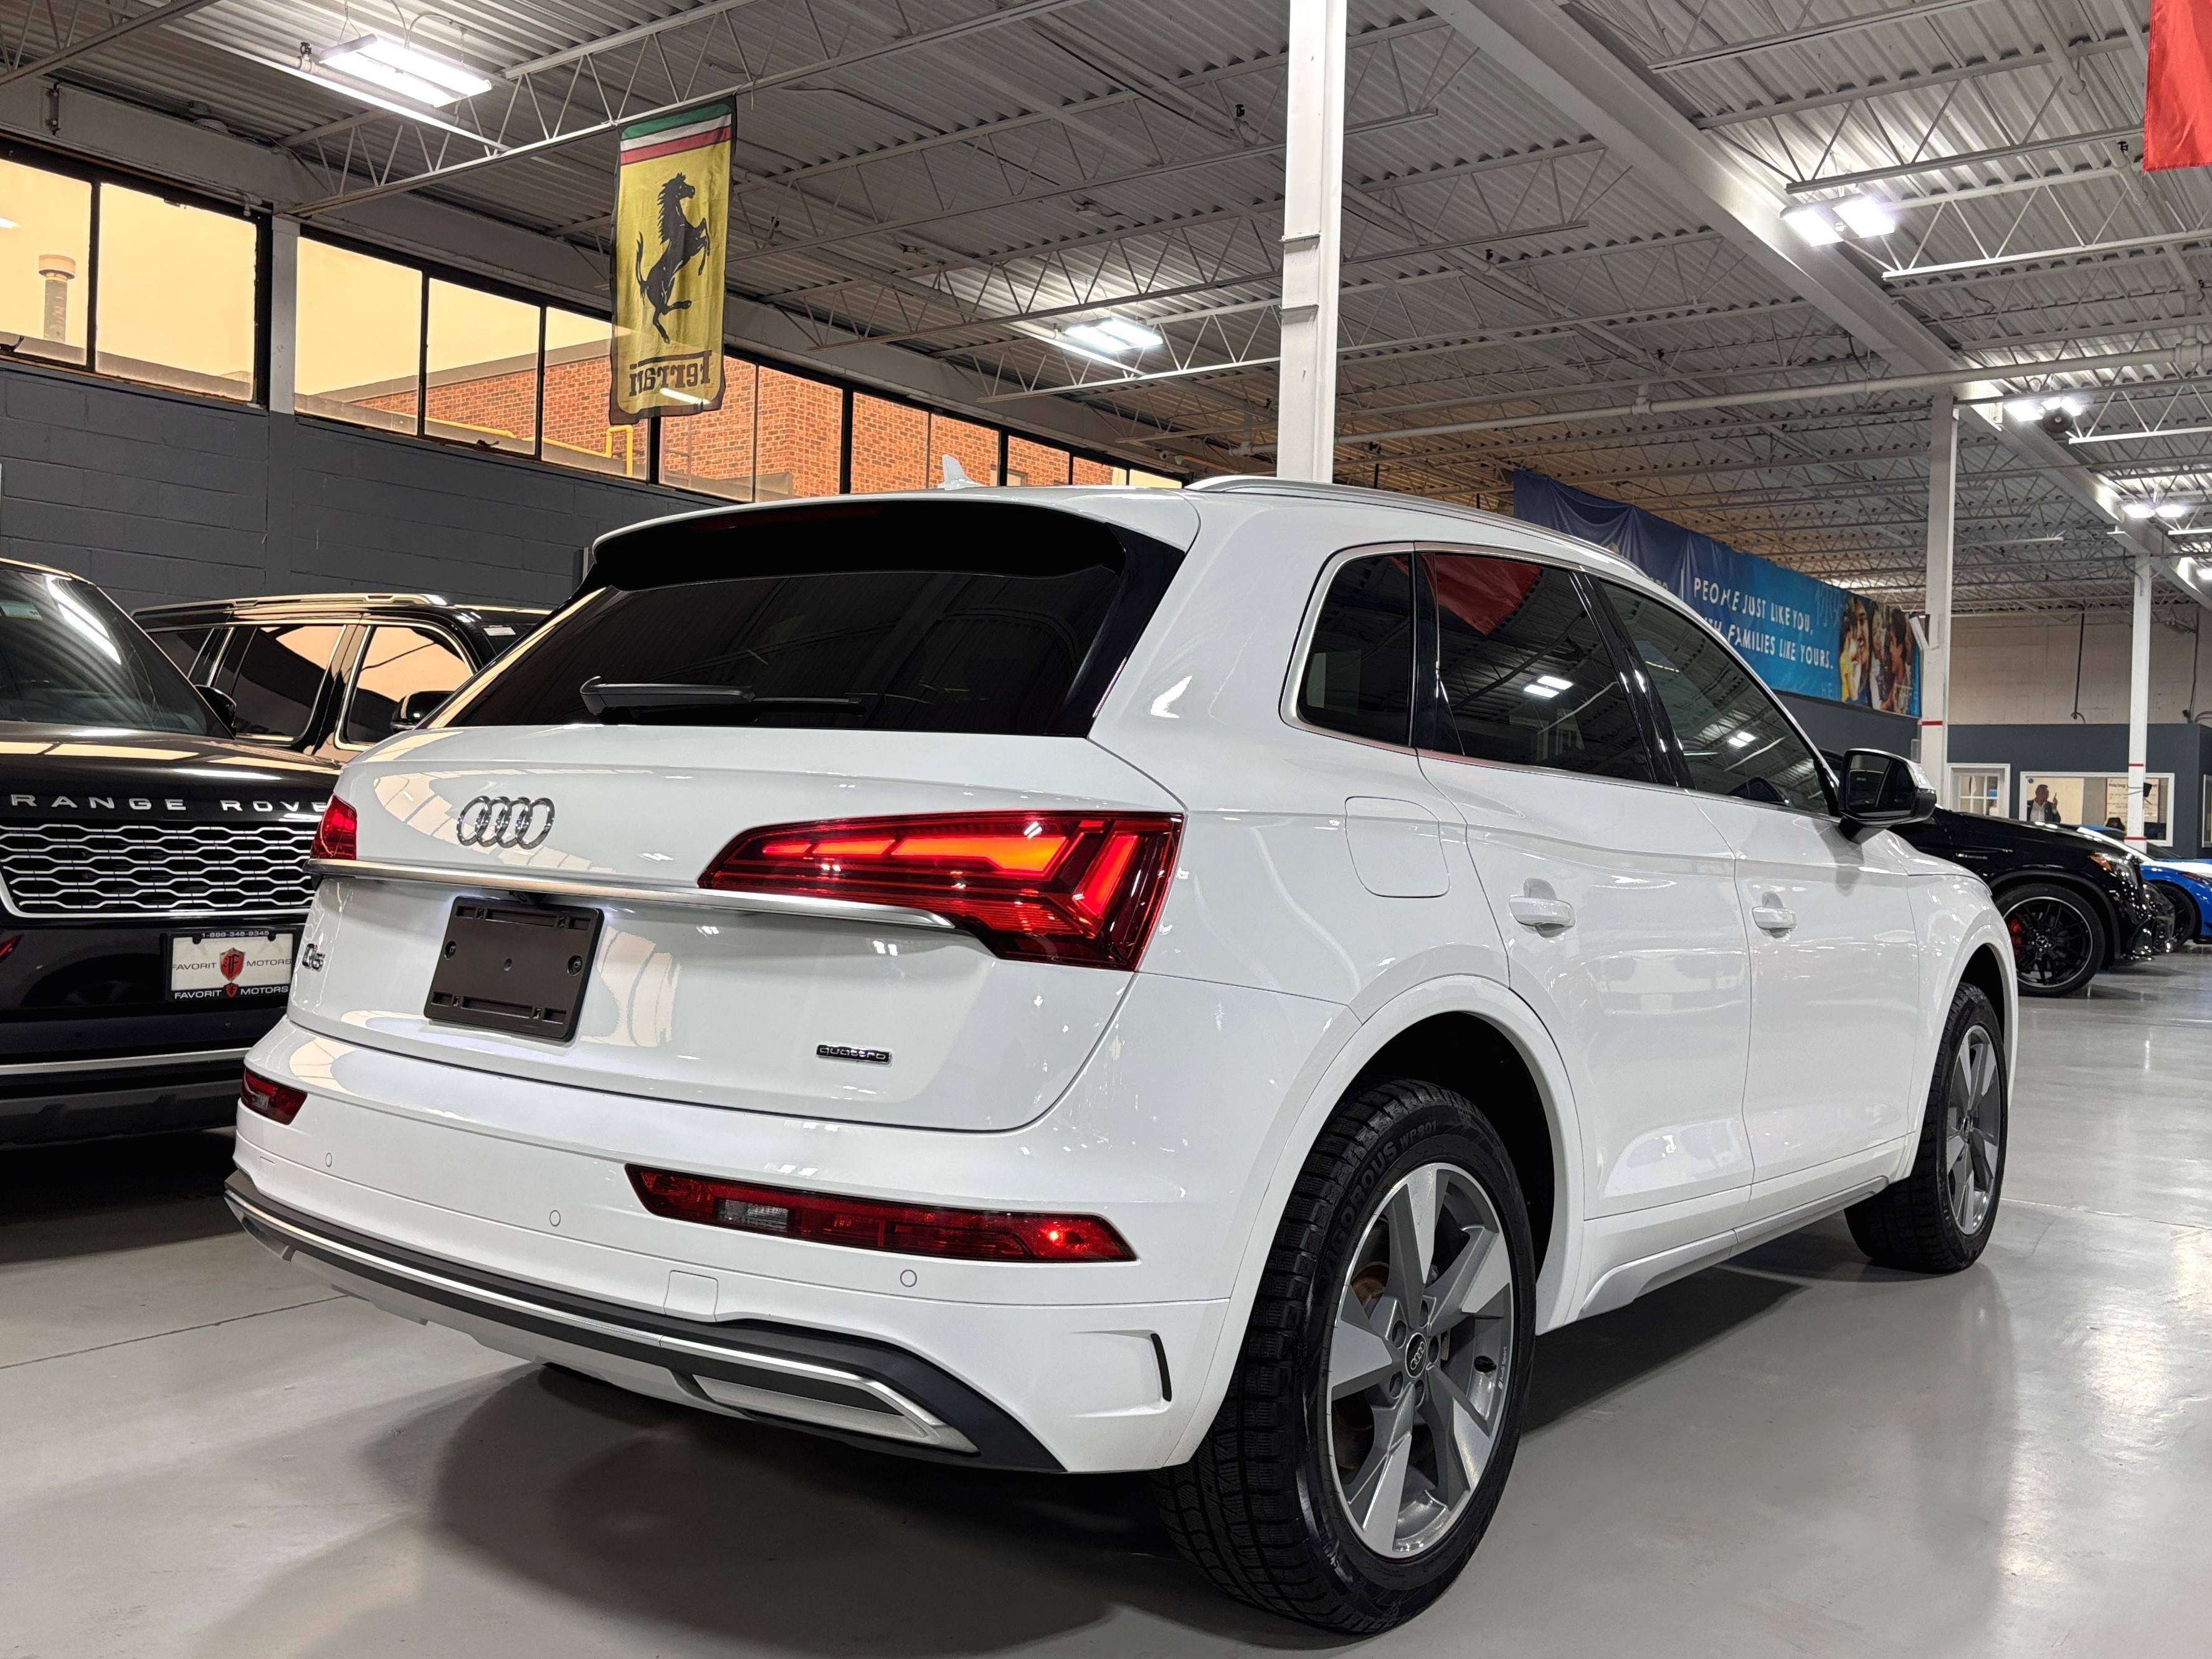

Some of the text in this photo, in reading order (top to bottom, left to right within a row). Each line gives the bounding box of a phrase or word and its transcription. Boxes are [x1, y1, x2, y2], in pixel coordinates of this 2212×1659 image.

[1742, 595, 1767, 619] JUST
[1770, 602, 1791, 626] LIKE
[1792, 610, 1813, 635] YOU,
[1727, 624, 1775, 655] FAMILIES
[1779, 639, 1797, 661] LIKE
[1800, 645, 1834, 669] YOURS.
[11, 794, 326, 812] RANGE ROVE
[172, 958, 292, 971] FAVORIT MOTORS
[174, 985, 288, 1000] FAVORIT MOTORS
[819, 1047, 886, 1060] quattro
